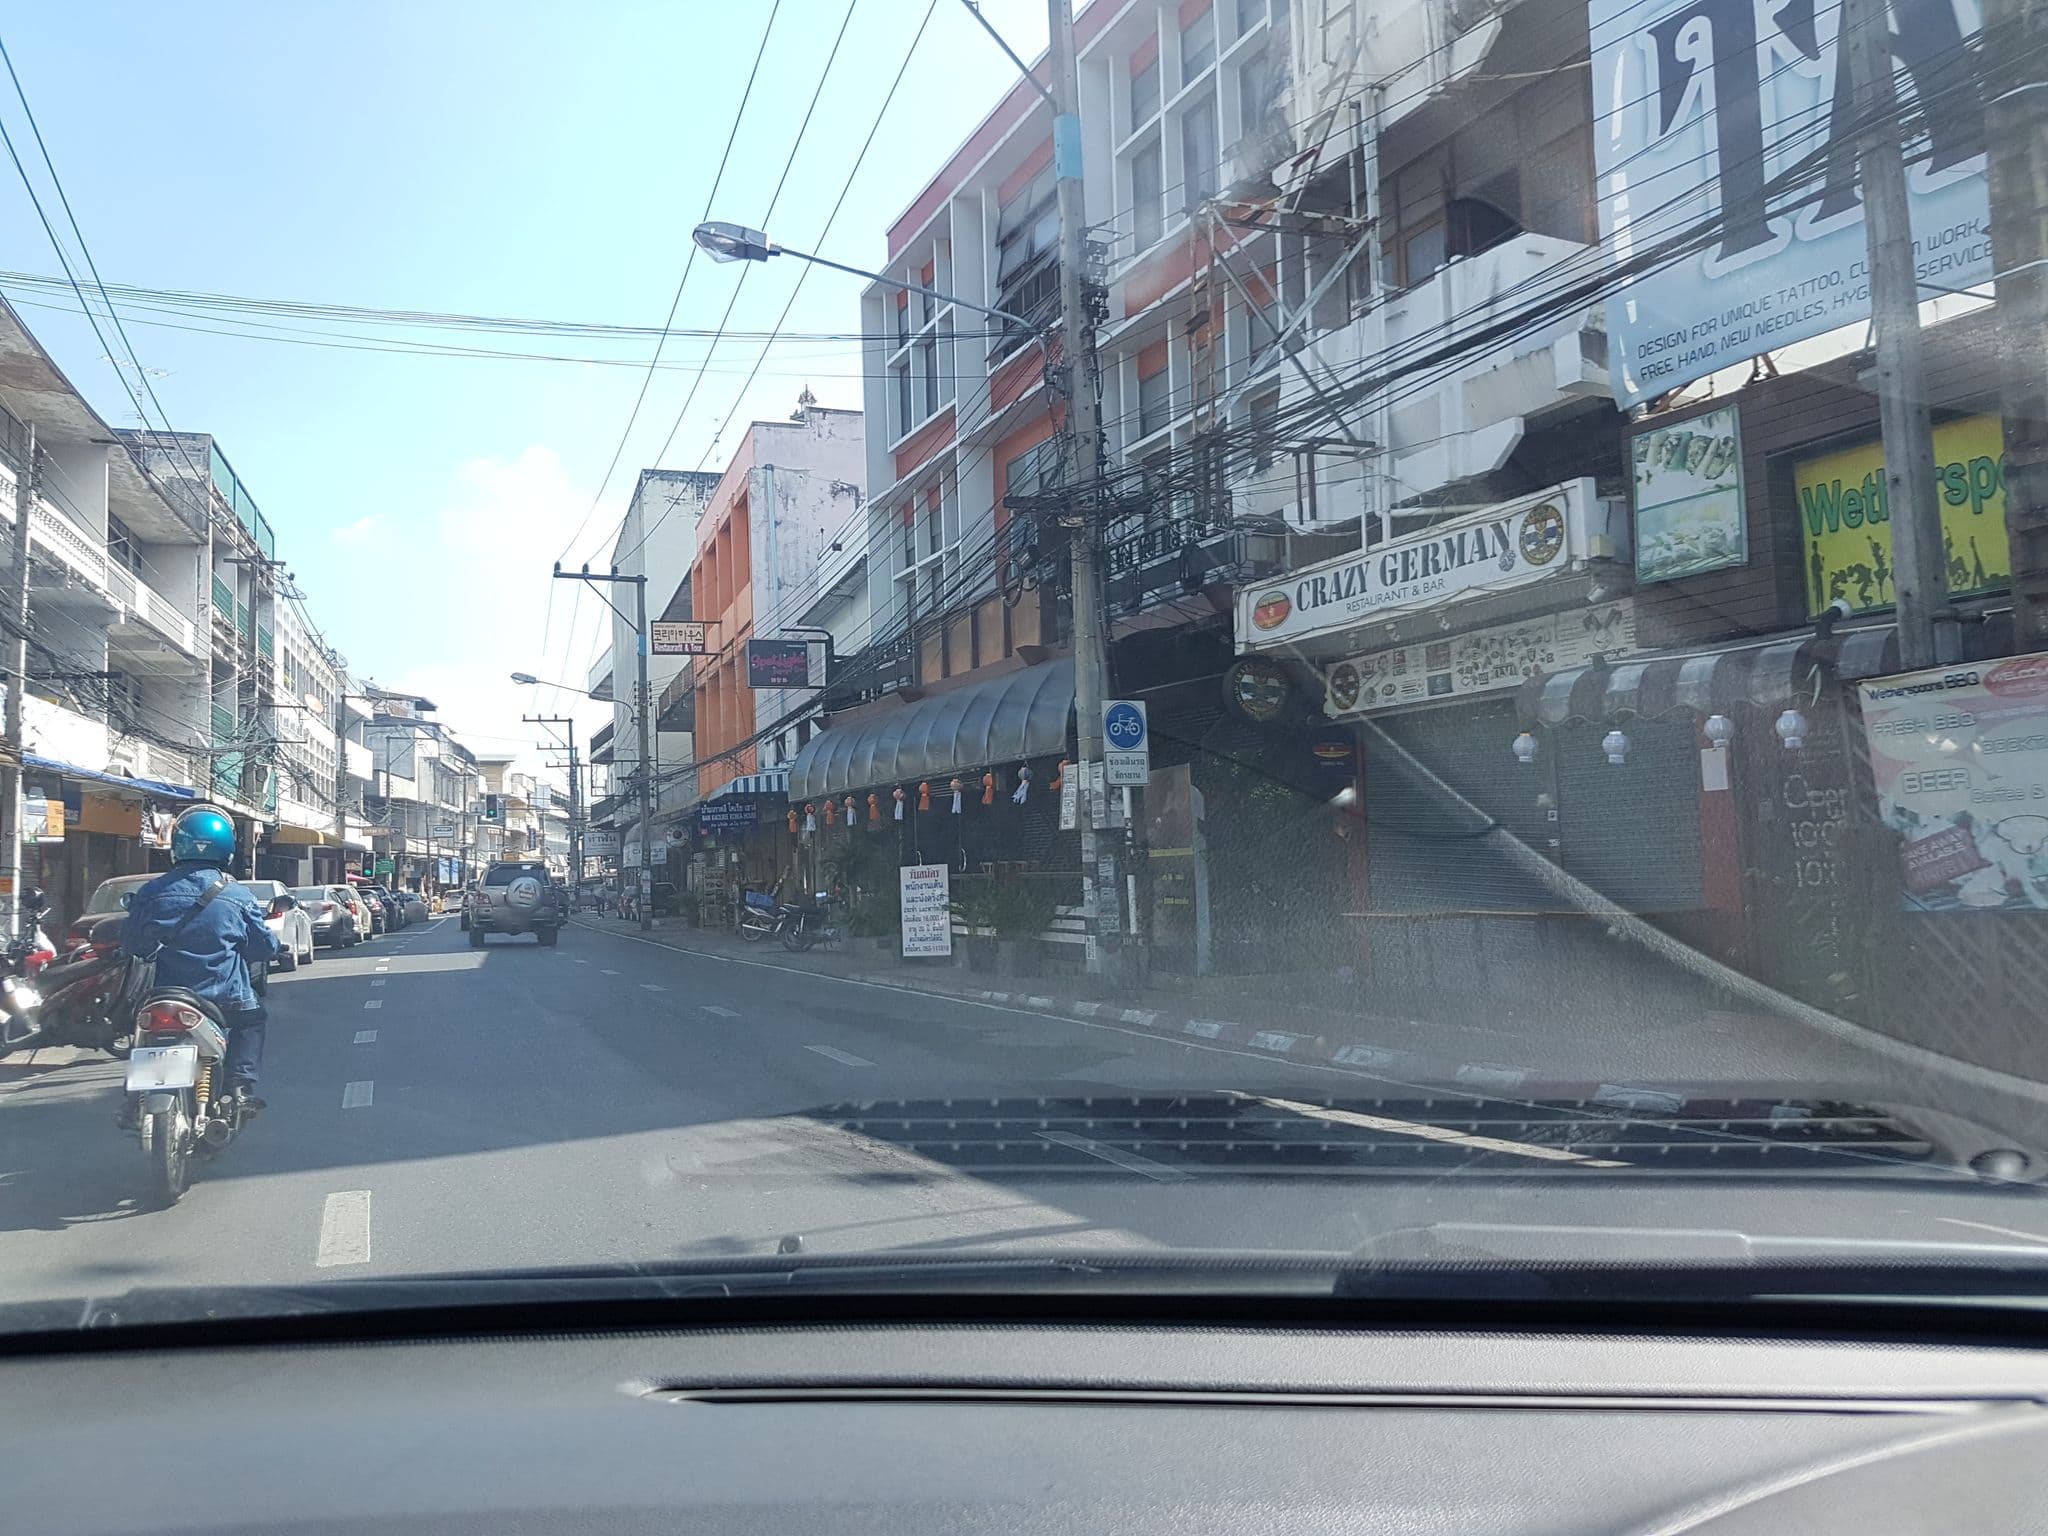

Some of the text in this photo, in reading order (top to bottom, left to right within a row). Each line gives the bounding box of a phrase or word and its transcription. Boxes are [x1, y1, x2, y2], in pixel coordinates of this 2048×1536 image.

[1638, 328, 1687, 360] DESIGN
[1692, 320, 1718, 341] FOR
[1721, 295, 1772, 328] UNIQUE
[1777, 270, 1844, 305] TATTOO,
[1640, 359, 1674, 381] FREE
[1677, 342, 1718, 369] HAND,
[1721, 329, 1751, 350] NEW
[1755, 299, 1828, 338] NEEDLES,
[1916, 239, 1993, 281] SERVICE
[1295, 560, 1370, 612] CRAZY
[1379, 518, 1512, 588] GERMAN
[1346, 578, 1445, 614] RESTAURANT & BAR
[654, 629, 702, 641] 코리아하우스
[1944, 671, 1980, 689] BBQ
[1903, 767, 1971, 795] BEER
